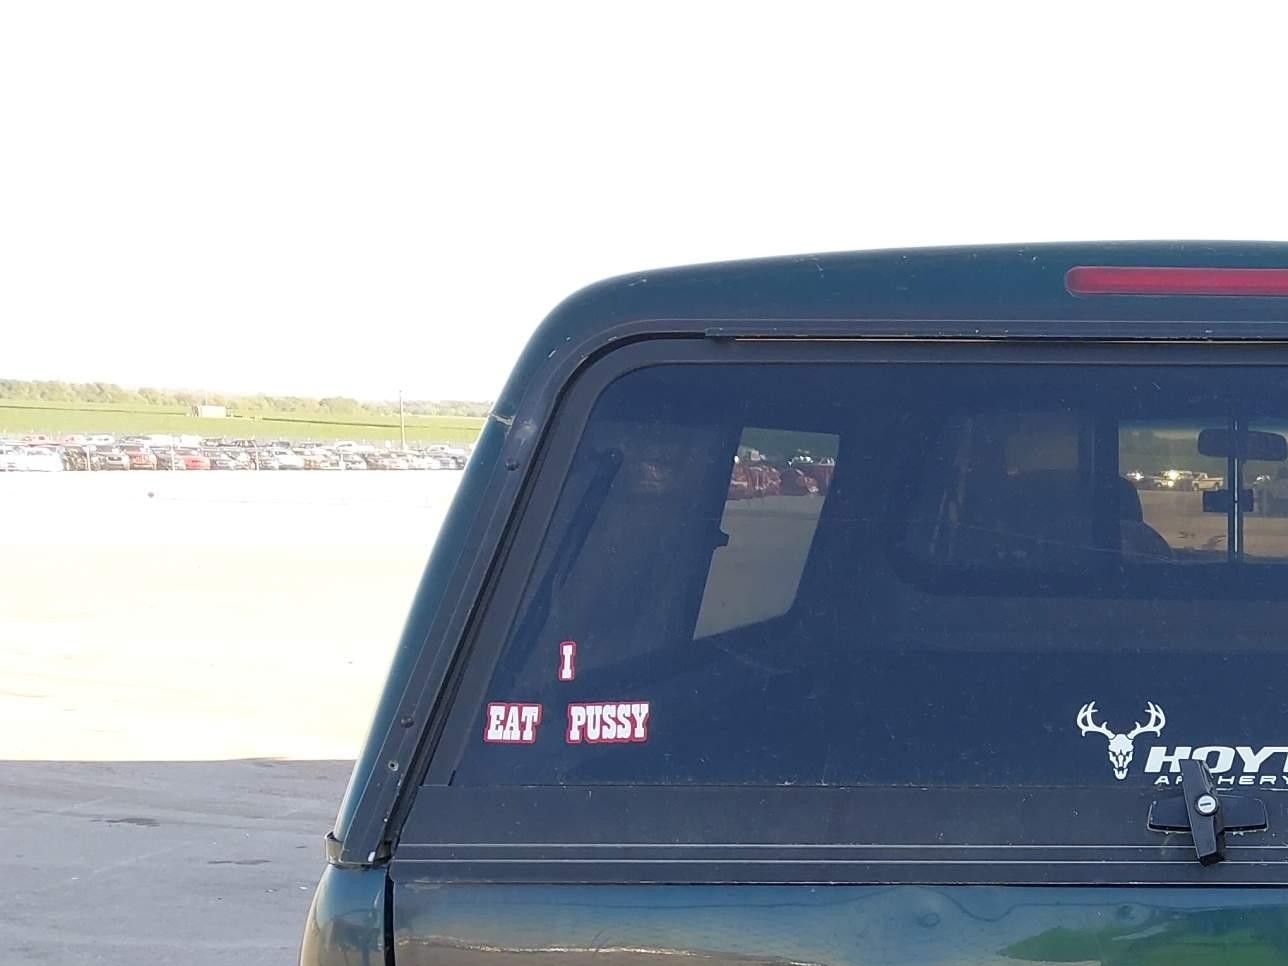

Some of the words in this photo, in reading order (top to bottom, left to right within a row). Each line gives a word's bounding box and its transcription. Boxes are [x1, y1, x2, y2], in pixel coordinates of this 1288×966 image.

[560, 643, 575, 680] I
[485, 704, 540, 742] EAT
[569, 702, 649, 742] PUSSY
